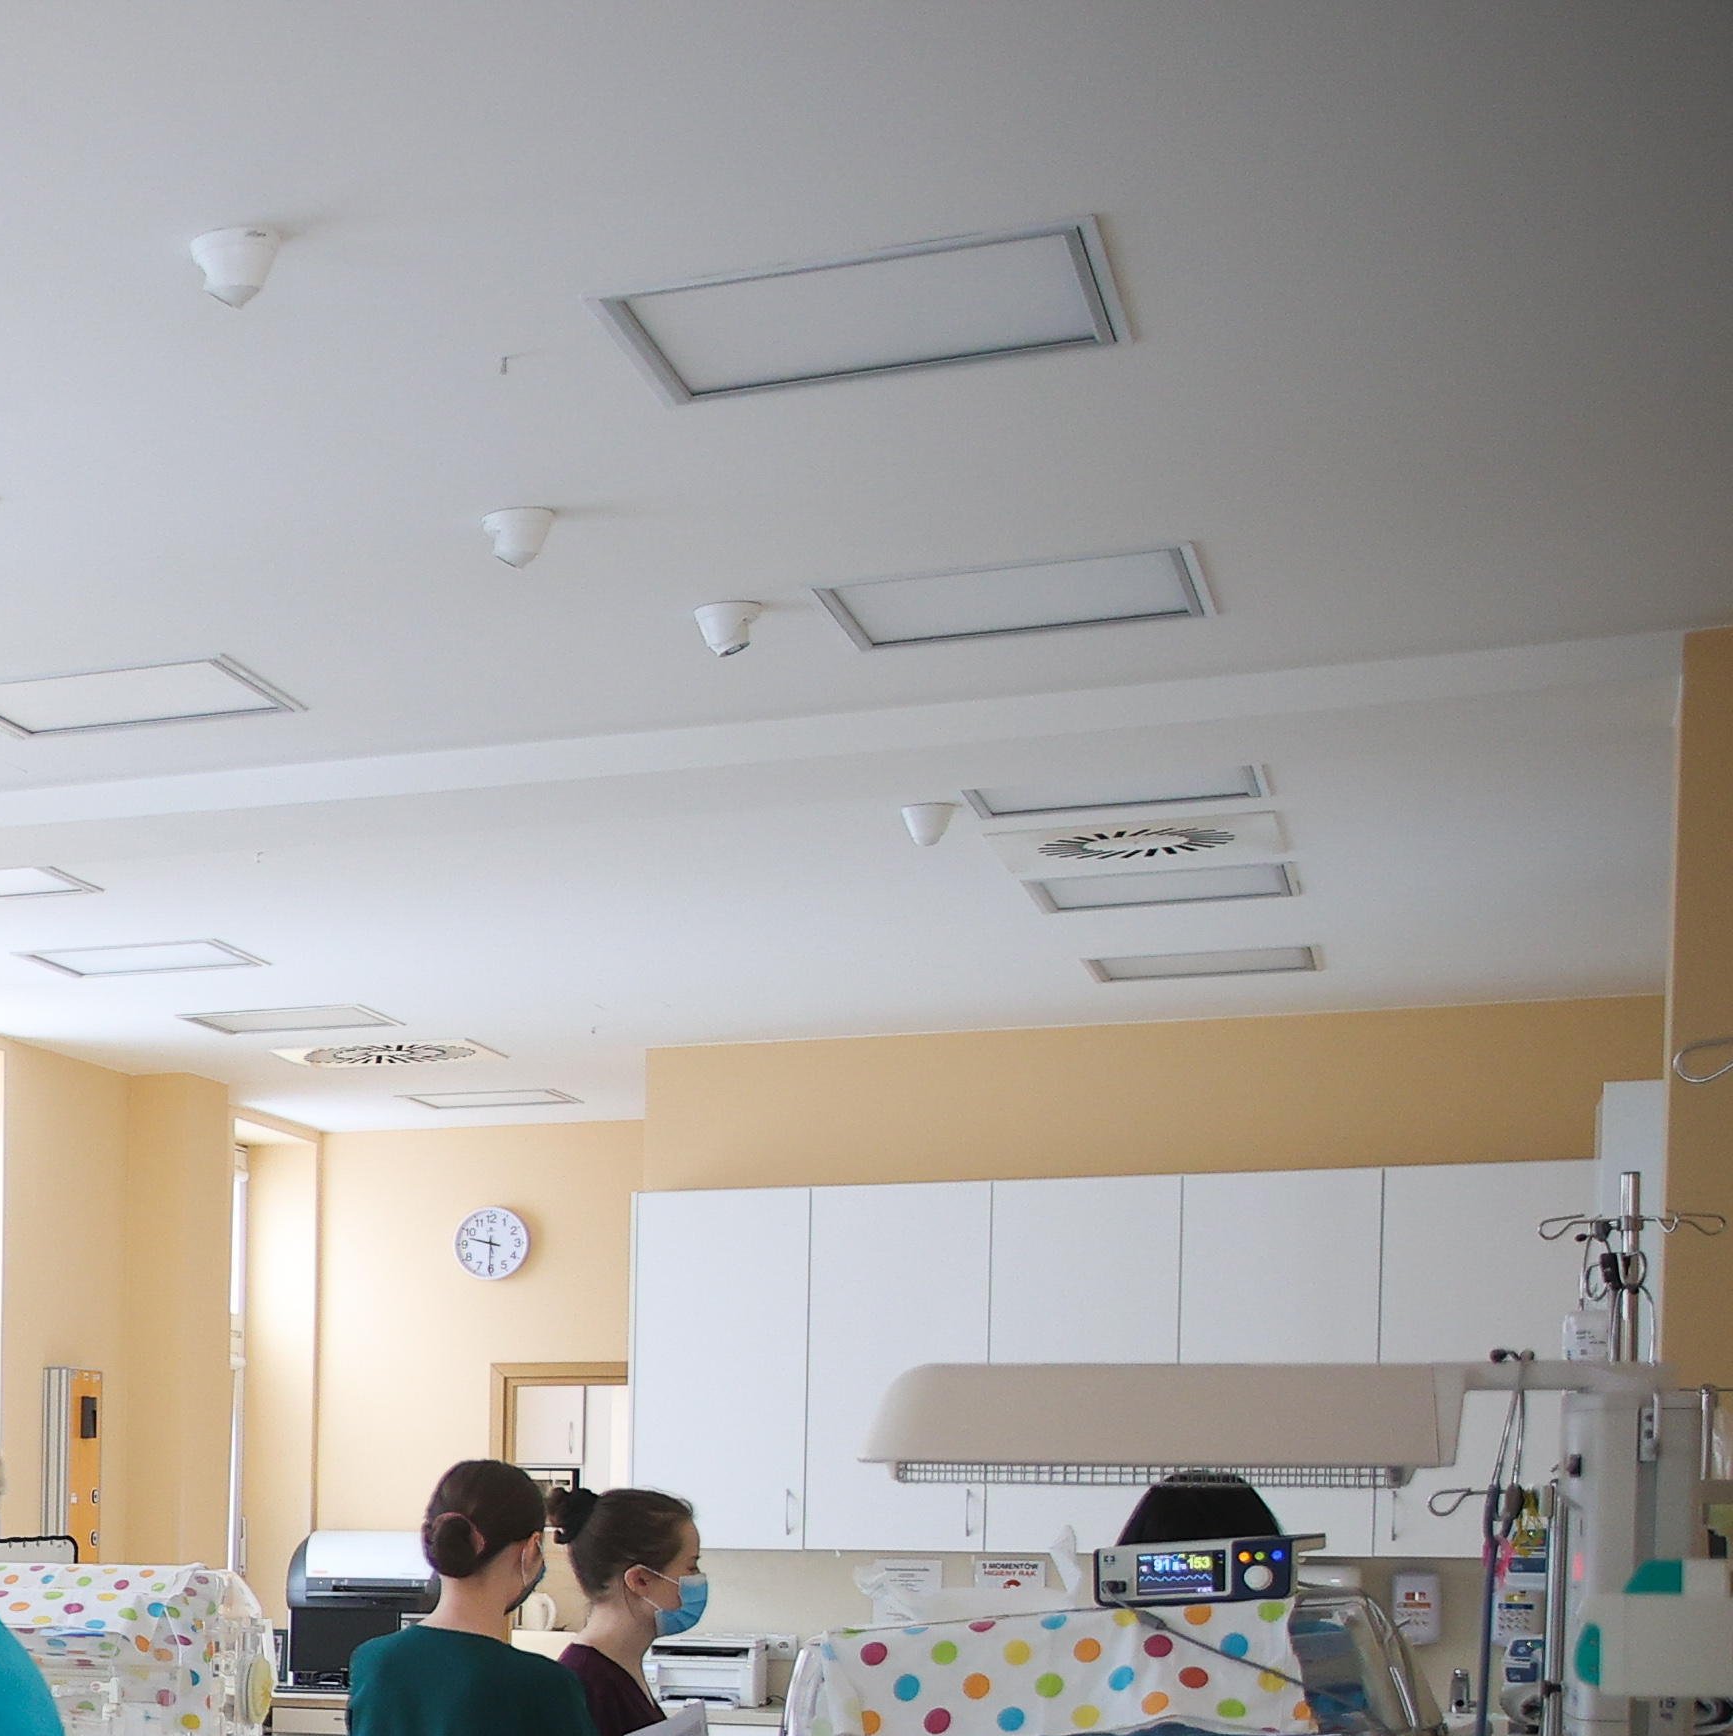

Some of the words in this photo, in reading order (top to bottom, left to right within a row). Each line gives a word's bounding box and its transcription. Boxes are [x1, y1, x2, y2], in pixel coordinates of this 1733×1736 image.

[475, 1219, 483, 1227] 11
[486, 1214, 497, 1224] 12
[502, 1218, 506, 1226] 1
[465, 1228, 476, 1236] 10
[510, 1226, 518, 1235] 2
[461, 1240, 468, 1249] 9
[514, 1238, 521, 1248] 3
[465, 1253, 472, 1261] 8
[510, 1251, 517, 1259] 4
[476, 1261, 482, 1270] 7
[487, 1264, 494, 1273] 6
[501, 1260, 507, 1269] 5
[1153, 1559, 1170, 1572] 91
[1187, 1554, 1211, 1571] 153
